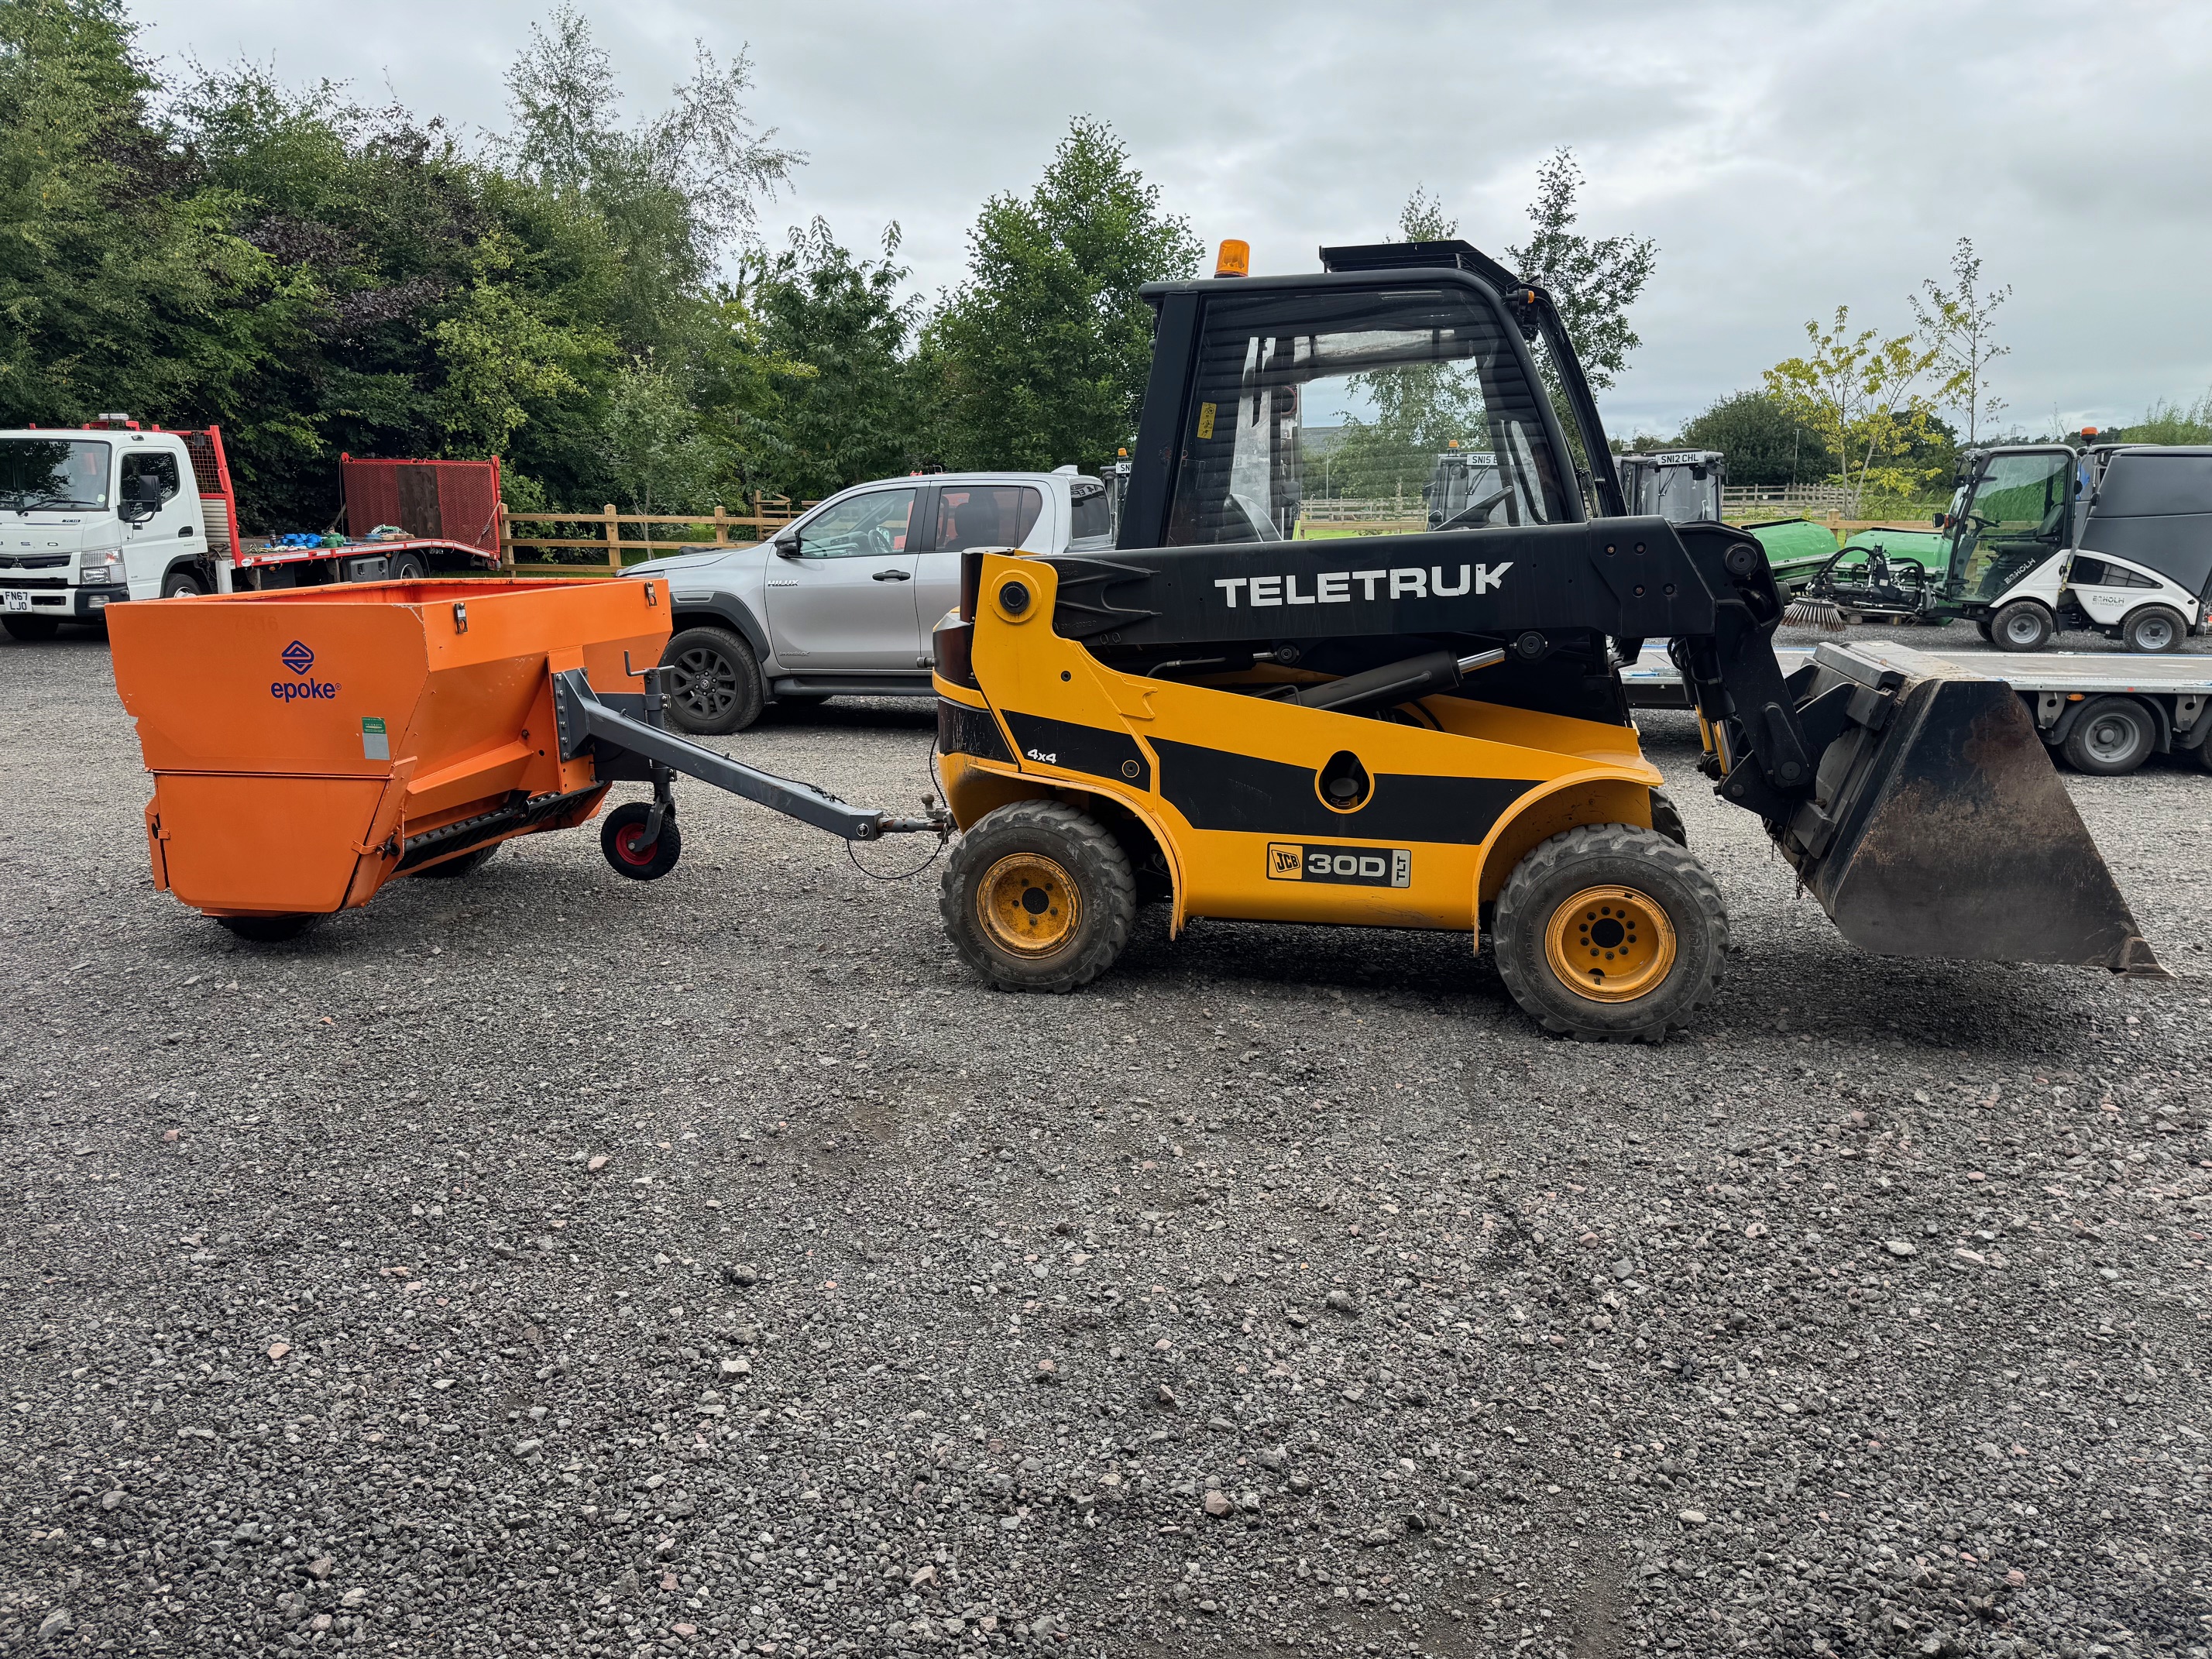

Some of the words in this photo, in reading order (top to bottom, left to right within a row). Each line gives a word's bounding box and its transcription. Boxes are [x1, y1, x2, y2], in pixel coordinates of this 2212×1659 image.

[1472, 455, 1491, 464] SN15
[1661, 455, 1680, 463] SN12
[1682, 453, 1698, 462] CHL
[1214, 562, 1514, 608] TELETRUK
[5, 592, 28, 600] FN67
[1027, 748, 1056, 764] 4x4
[1276, 853, 1299, 870] JCB
[1307, 854, 1386, 878] 30D
[1396, 856, 1407, 881] TLT
